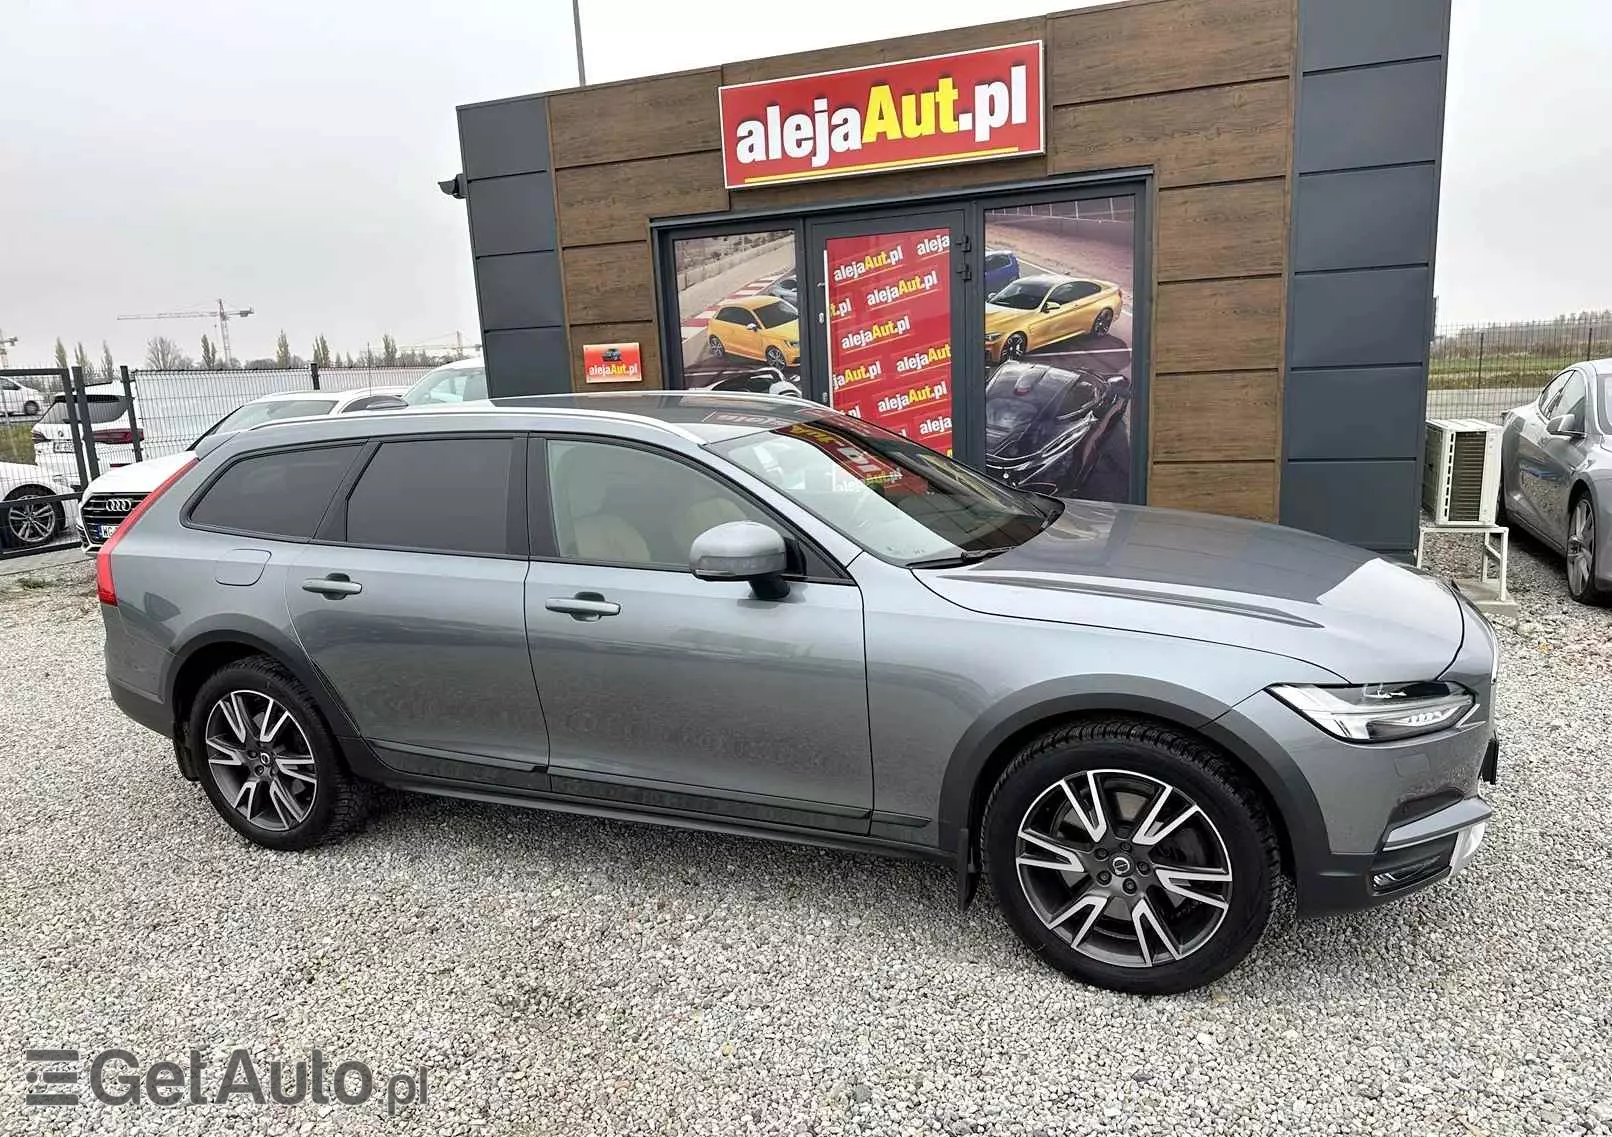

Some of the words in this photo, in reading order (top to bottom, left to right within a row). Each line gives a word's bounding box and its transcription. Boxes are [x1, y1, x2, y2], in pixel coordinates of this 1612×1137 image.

[736, 65, 1028, 167] alejaAut.pl
[916, 234, 949, 256] aleja
[833, 245, 904, 281] alejaAut.pl
[866, 270, 938, 306] alejaAut.pl
[841, 315, 911, 349] alejaAut.pl
[588, 363, 638, 376] alejaAut.pl
[896, 343, 951, 372] alejaAut
[877, 381, 948, 413] alejaAut.pl
[919, 416, 952, 435] aleja
